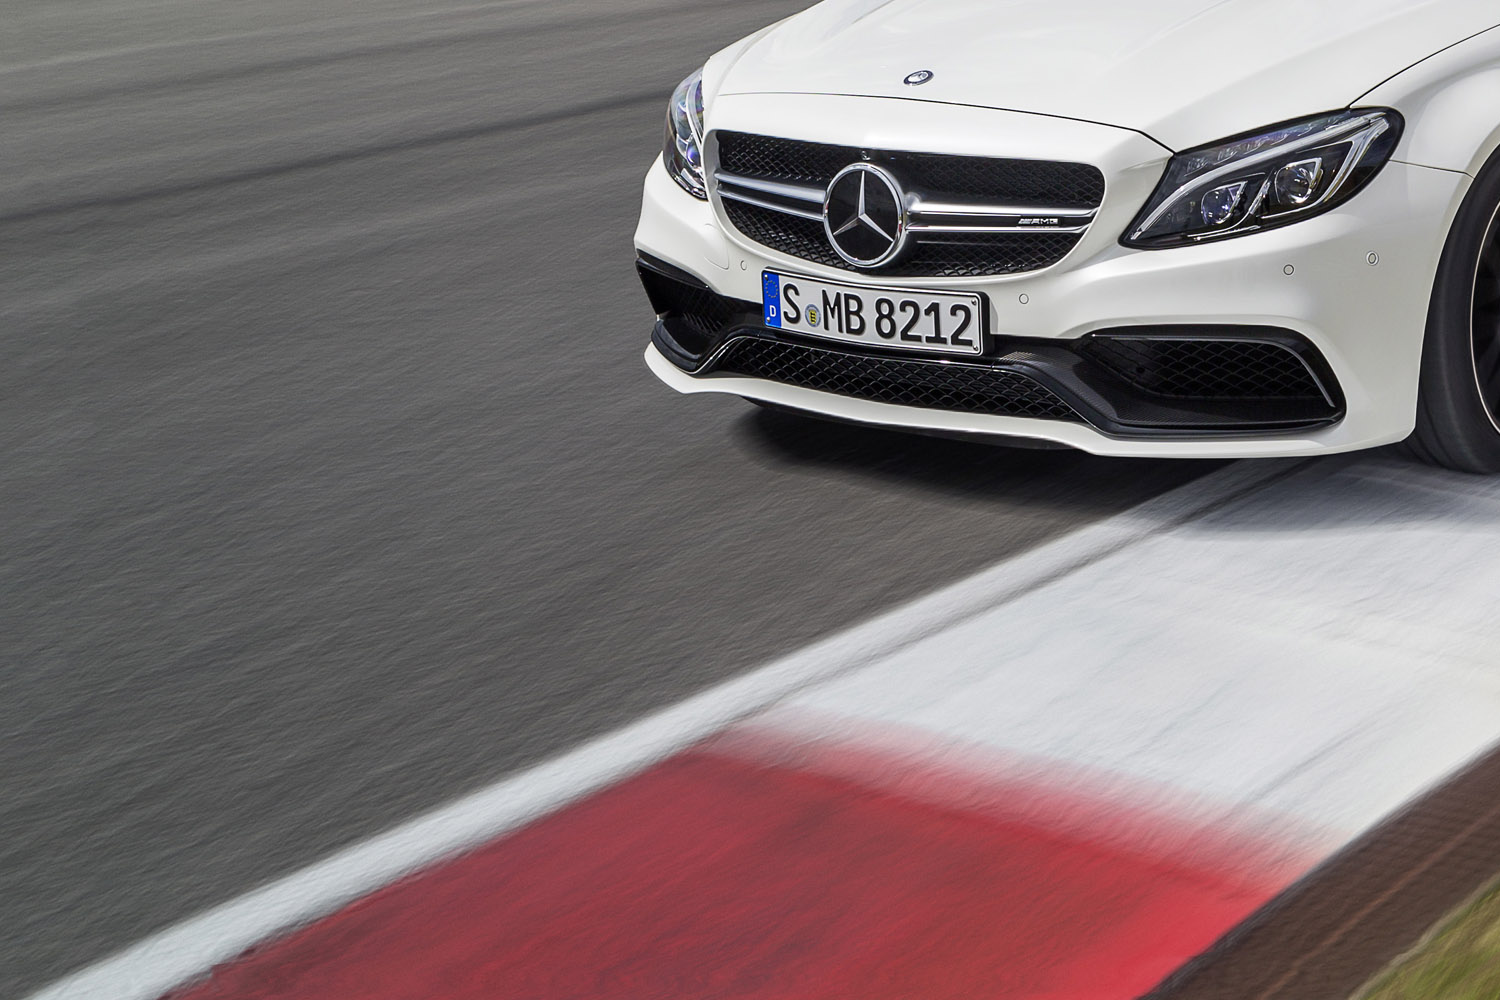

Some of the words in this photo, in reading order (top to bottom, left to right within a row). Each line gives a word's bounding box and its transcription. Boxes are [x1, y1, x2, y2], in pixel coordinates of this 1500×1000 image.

[769, 305, 777, 317] D
[783, 283, 801, 324] S
[822, 289, 866, 335] MB
[875, 298, 973, 346] 8212
